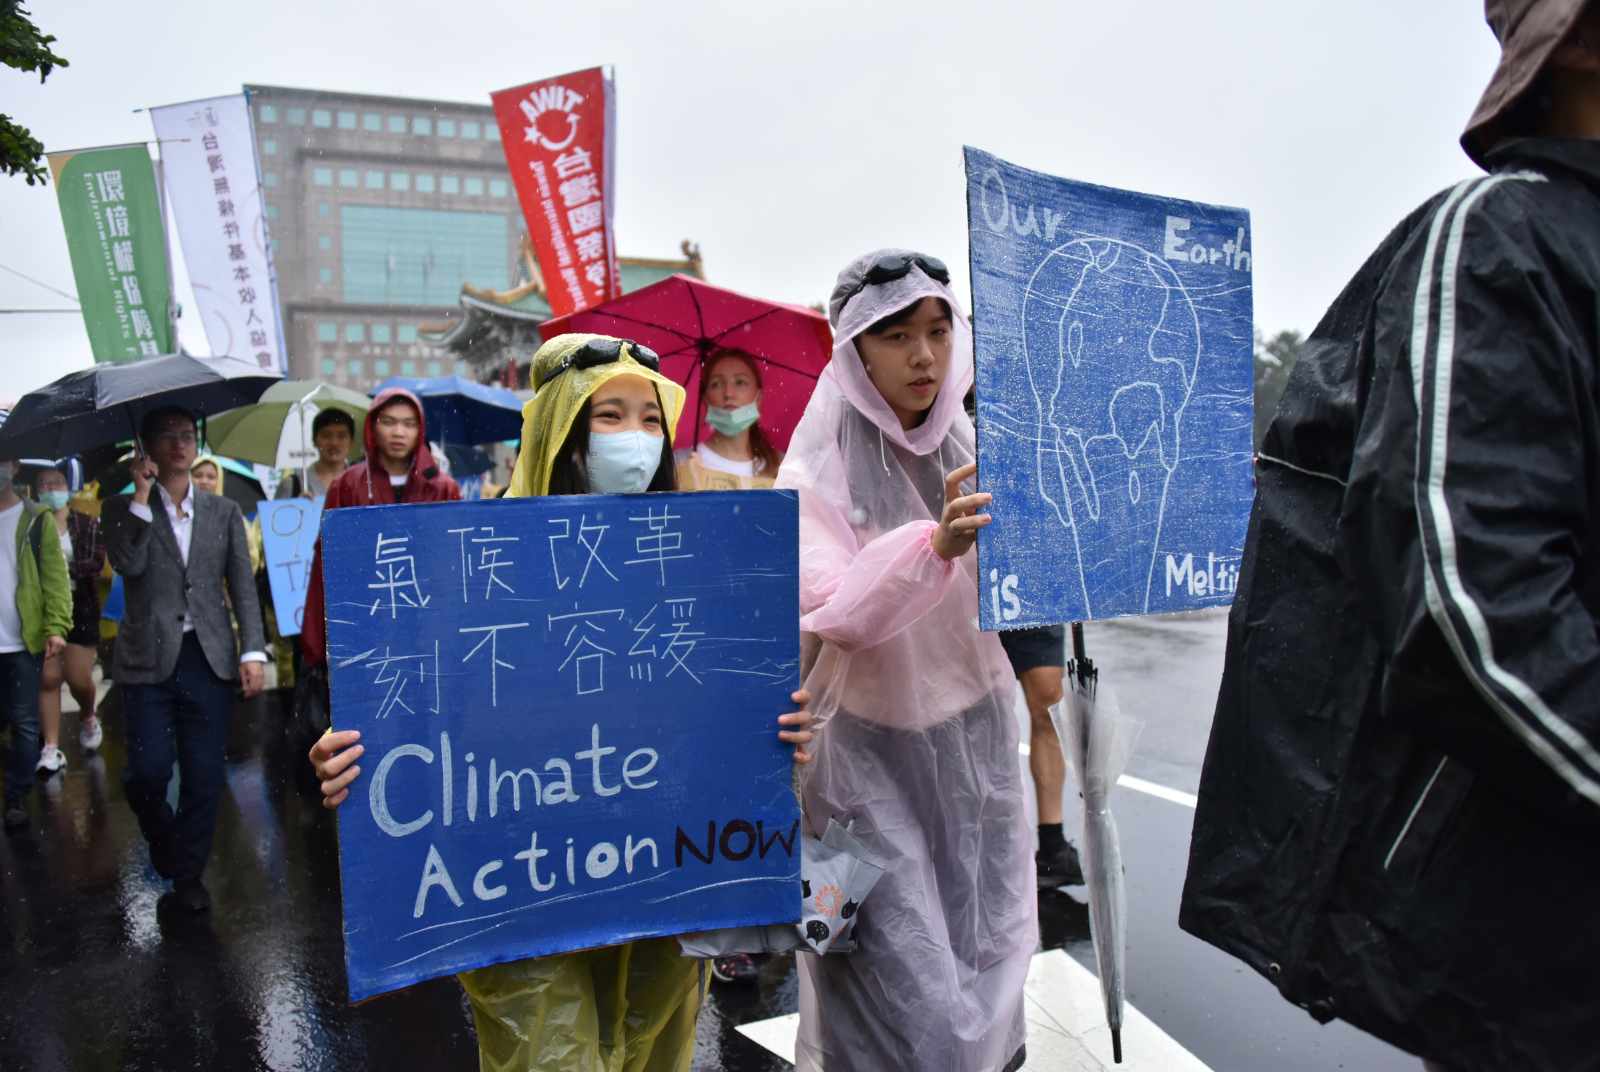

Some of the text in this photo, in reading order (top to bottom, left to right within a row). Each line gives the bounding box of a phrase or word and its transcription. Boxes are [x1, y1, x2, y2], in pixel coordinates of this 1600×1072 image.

[980, 167, 1252, 272] Our Earth
[367, 504, 693, 620] 氣候改革
[989, 567, 1022, 625] is
[366, 598, 705, 720] 刻不容緩
[368, 723, 660, 838] Climate
[413, 818, 799, 919] Action NOW
